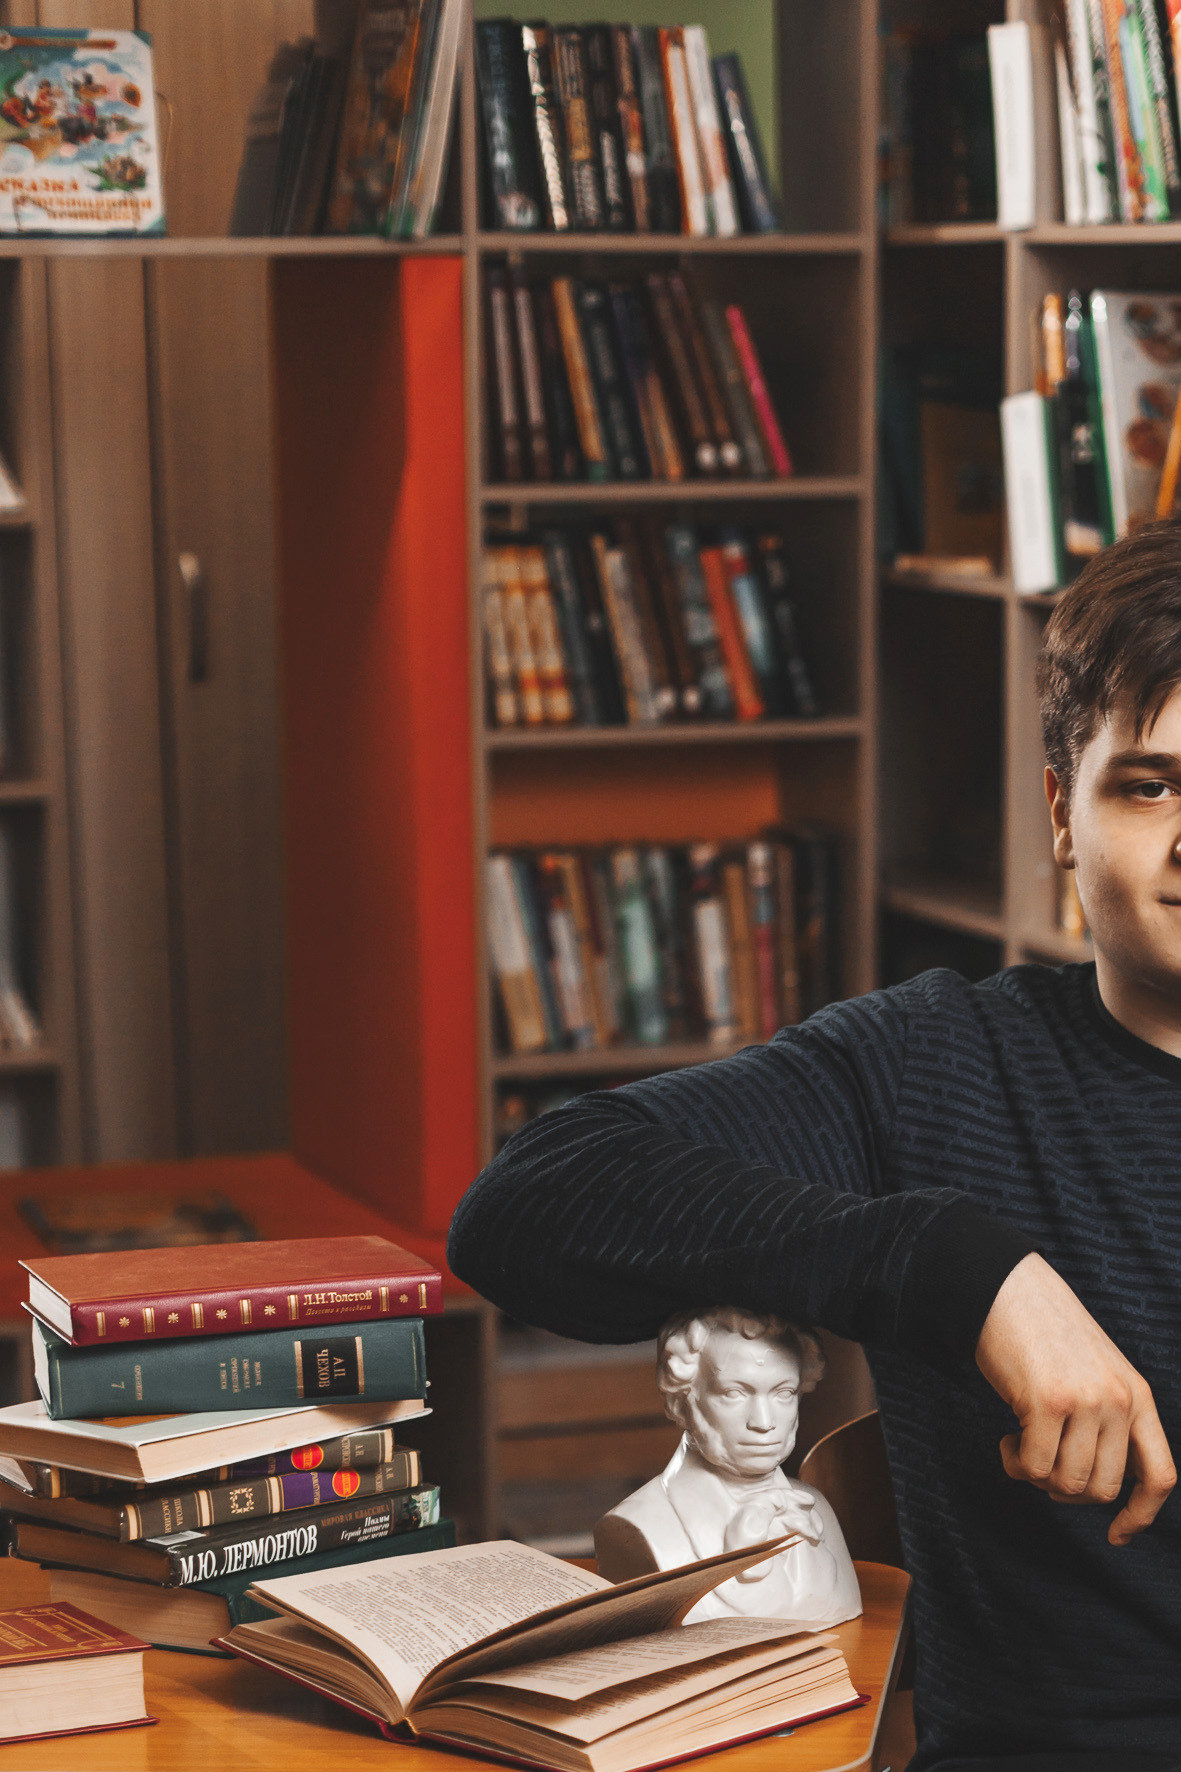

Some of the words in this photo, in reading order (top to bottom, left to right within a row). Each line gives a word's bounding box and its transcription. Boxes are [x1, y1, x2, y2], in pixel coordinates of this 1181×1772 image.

[316, 1349, 330, 1388] ЧЕХОВ
[111, 1380, 125, 1389] 7
[174, 1498, 184, 1526] ШКОЛА
[320, 1512, 352, 1527] МИРОВАЯ
[354, 1504, 390, 1520] КЛАССИКА
[179, 1550, 218, 1586] М.Ю.
[220, 1524, 318, 1576] ЛЕРМОНТОВ
